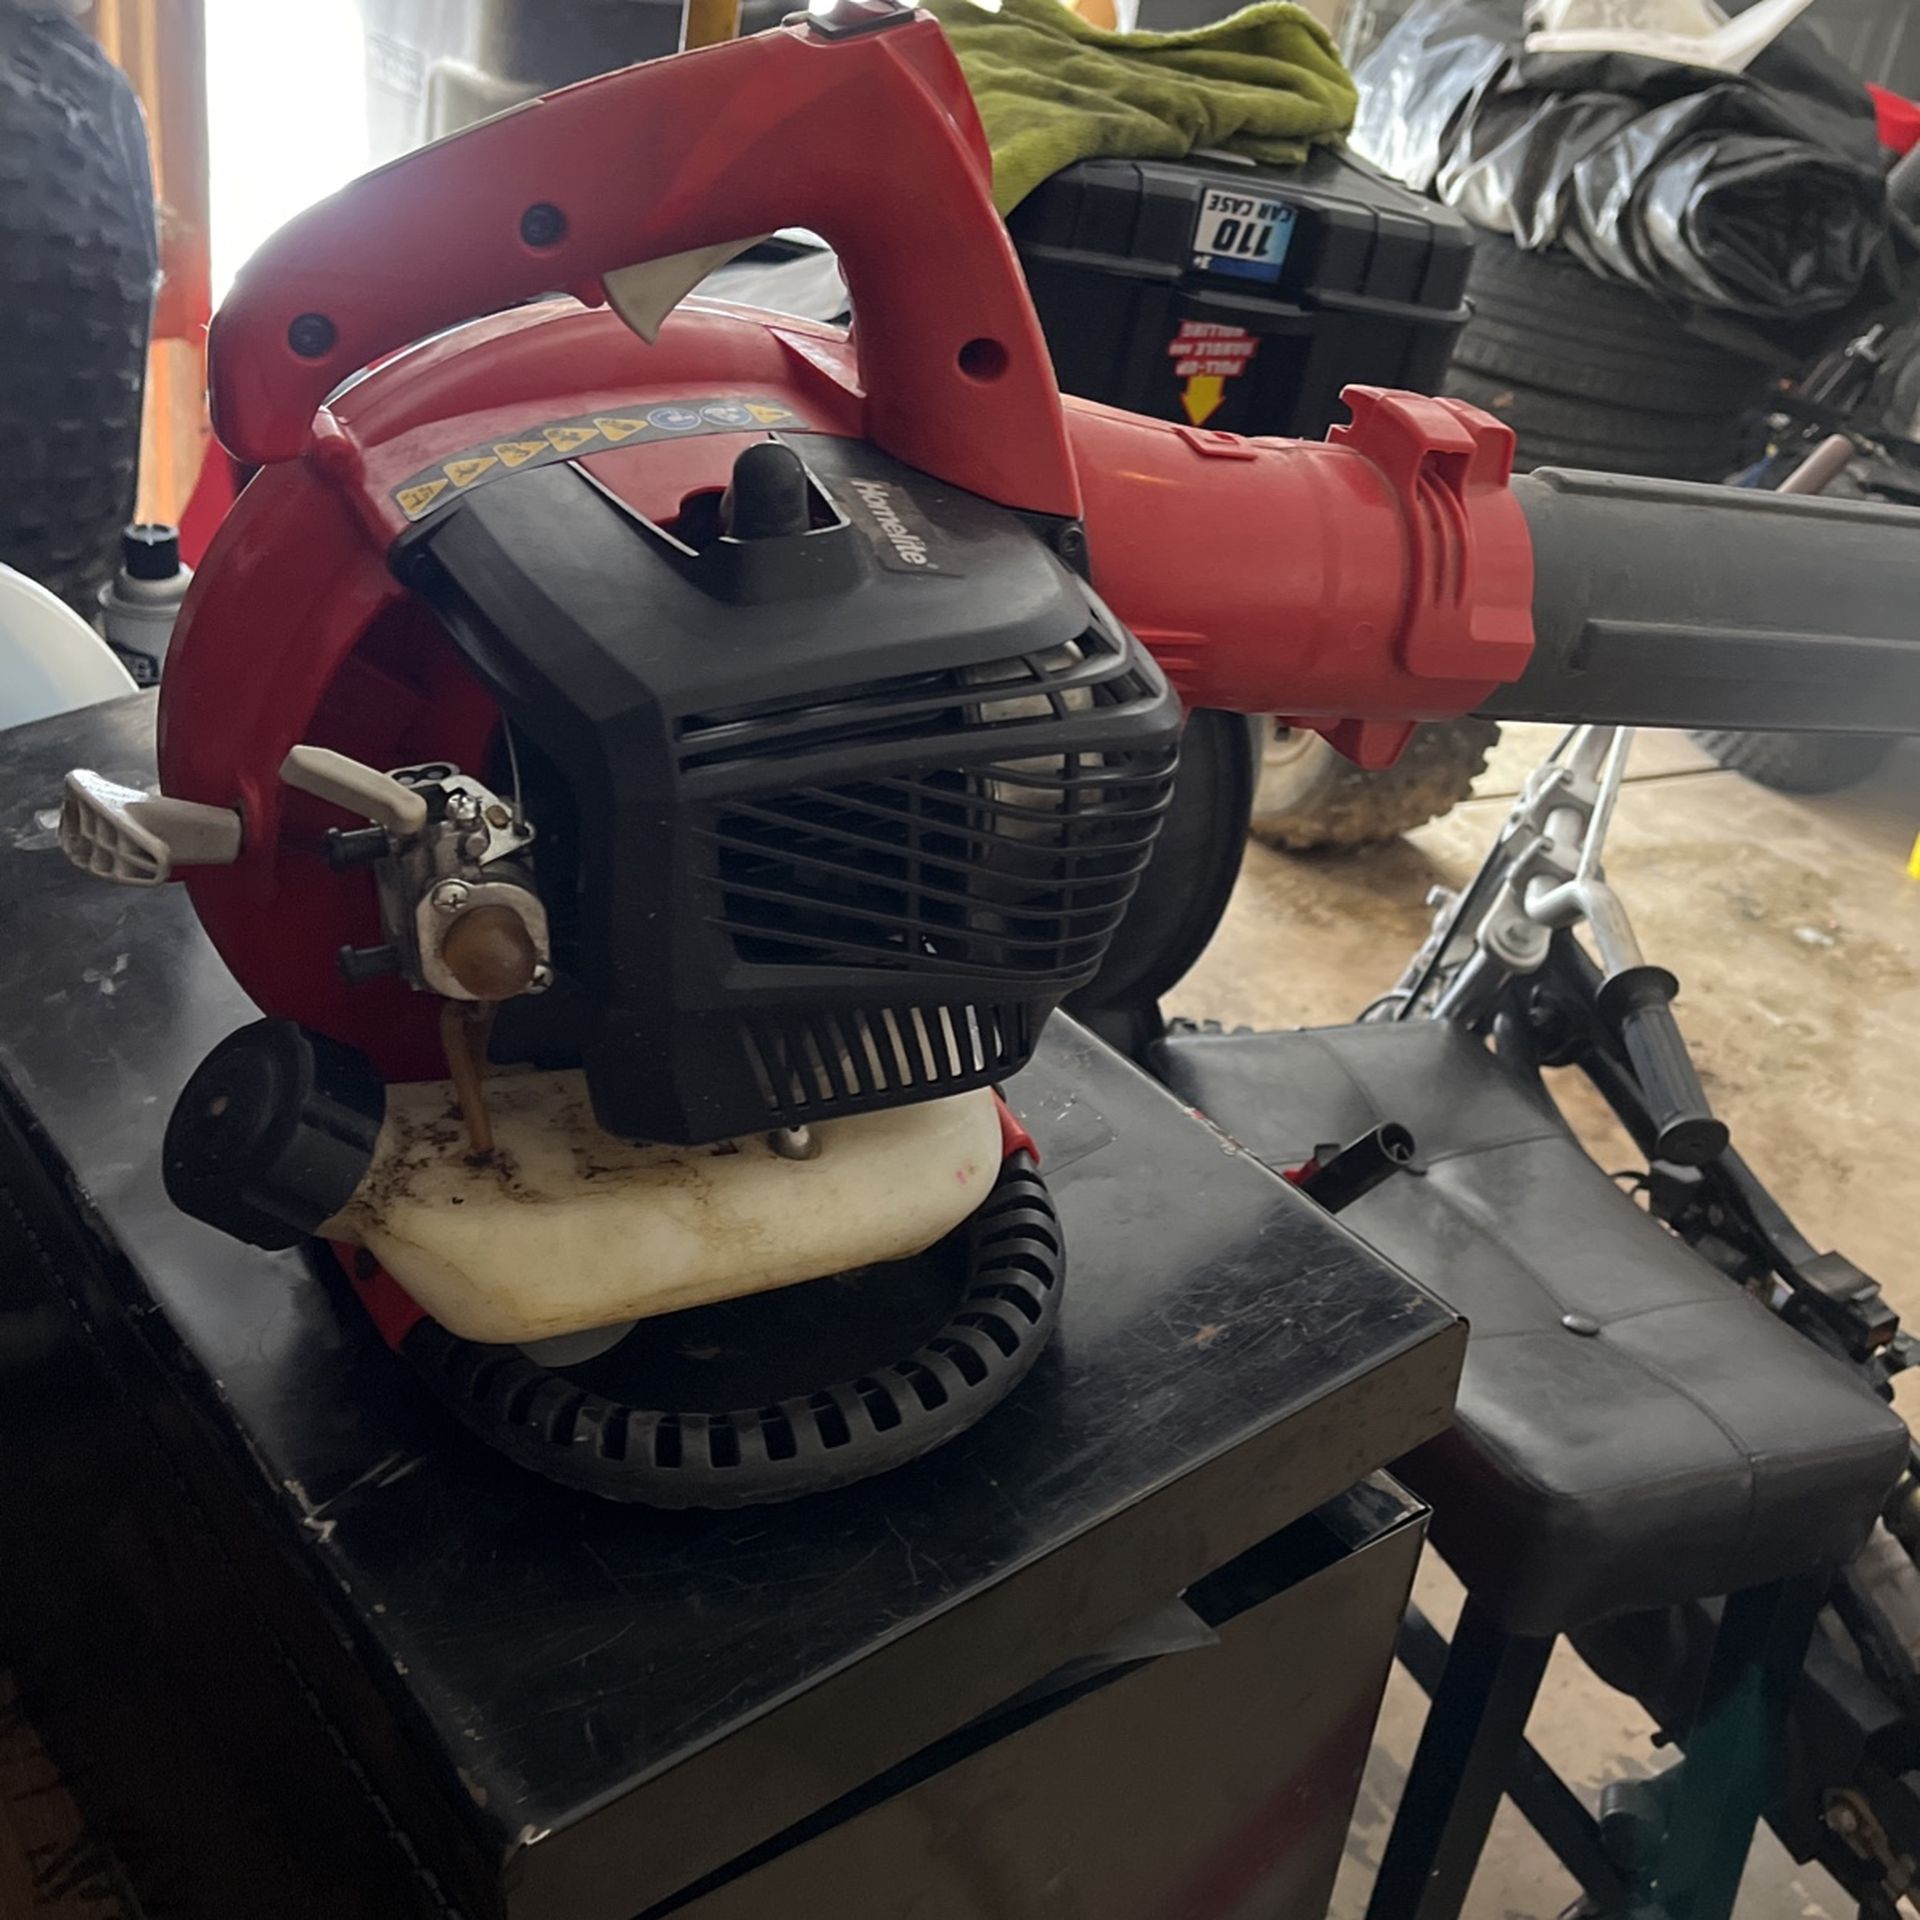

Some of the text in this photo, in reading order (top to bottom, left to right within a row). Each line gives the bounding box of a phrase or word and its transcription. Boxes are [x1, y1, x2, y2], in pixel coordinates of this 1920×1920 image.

[1207, 194, 1293, 223] CAR CASE
[1212, 219, 1273, 257] 110
[850, 480, 927, 566] Homelite
